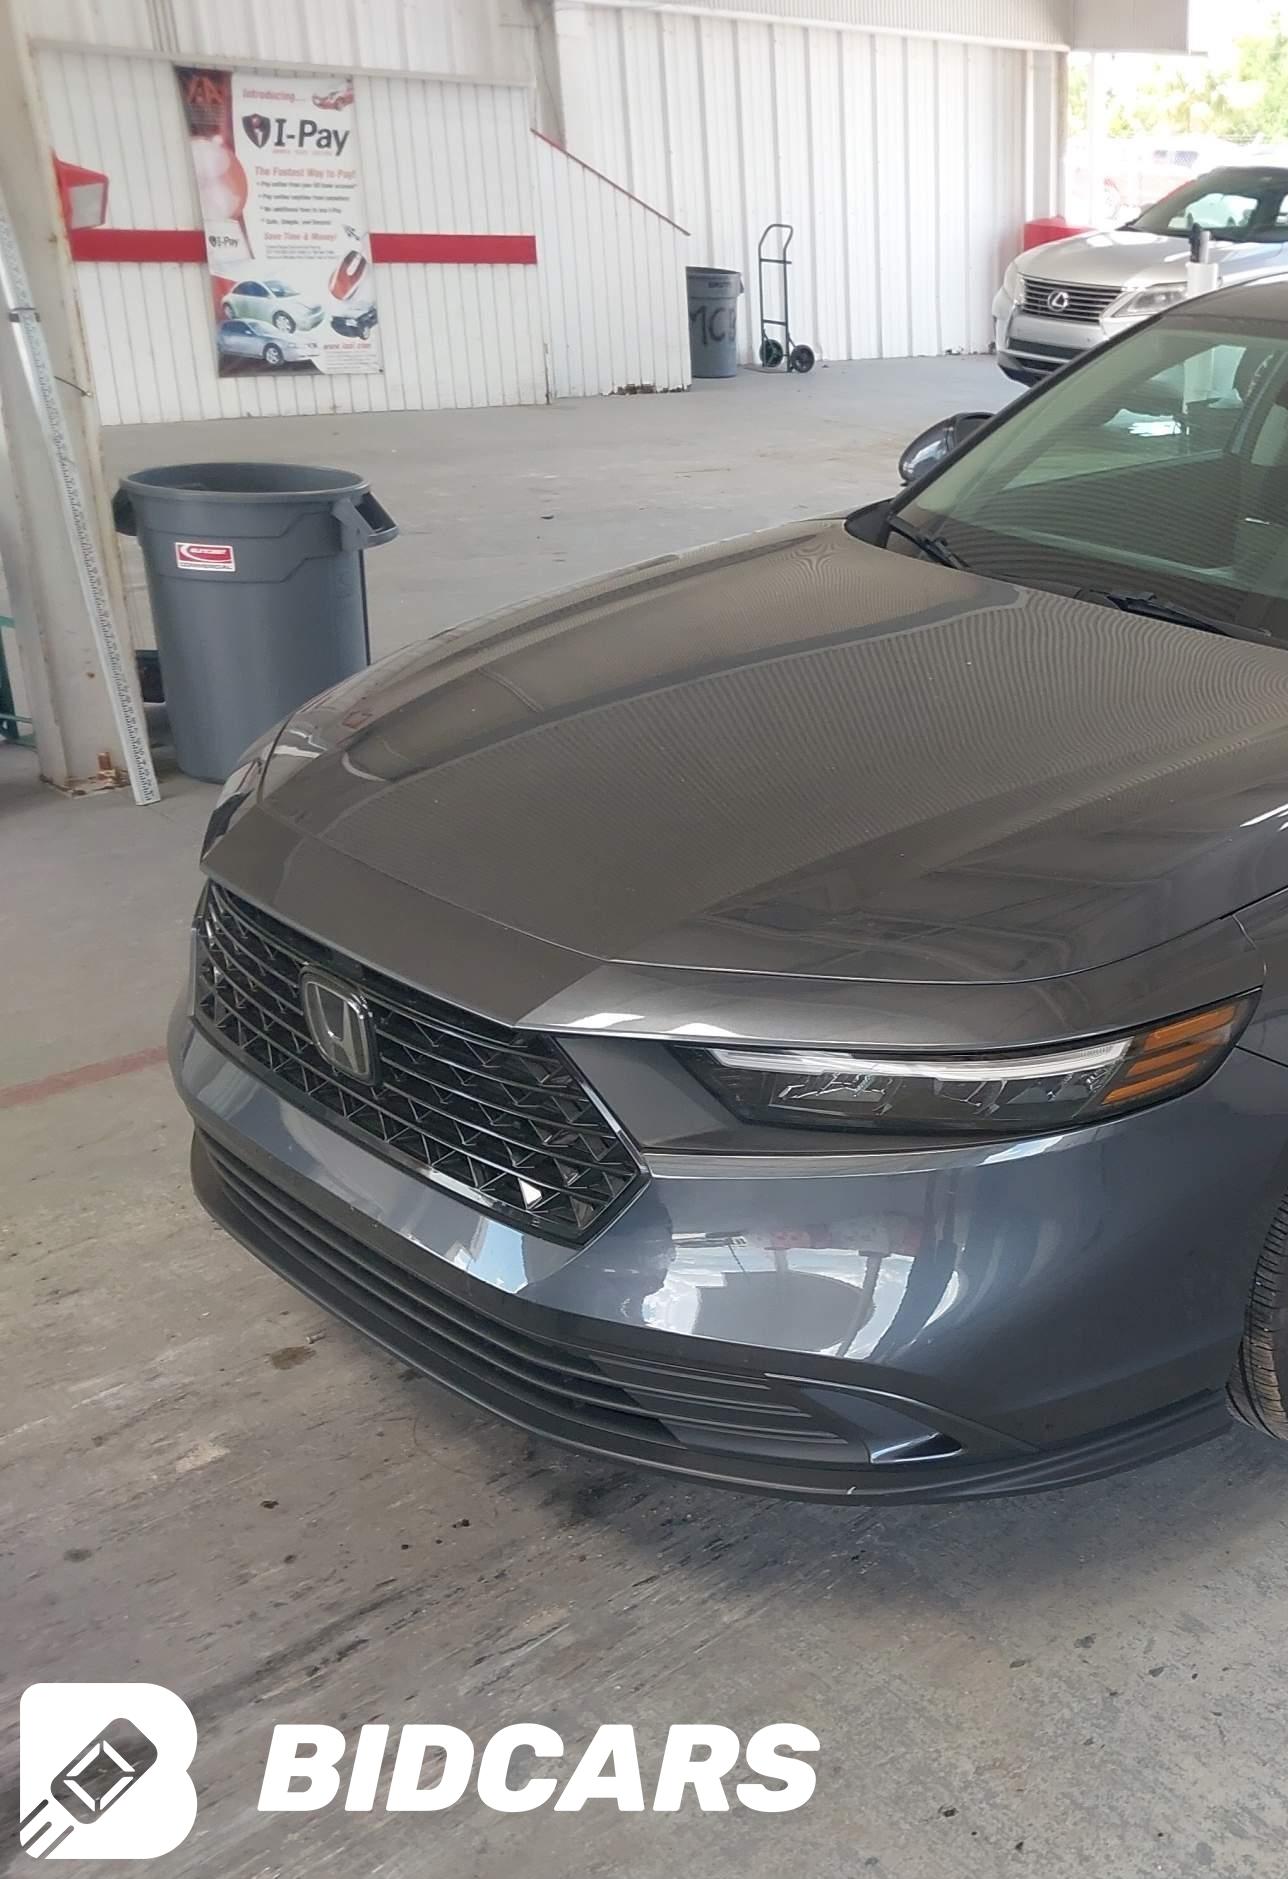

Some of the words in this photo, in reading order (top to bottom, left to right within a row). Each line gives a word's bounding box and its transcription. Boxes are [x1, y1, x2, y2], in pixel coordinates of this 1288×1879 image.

[274, 118, 350, 156] I-Pay
[255, 166, 270, 177] The
[273, 167, 304, 177] Fastest
[307, 168, 324, 179] Way
